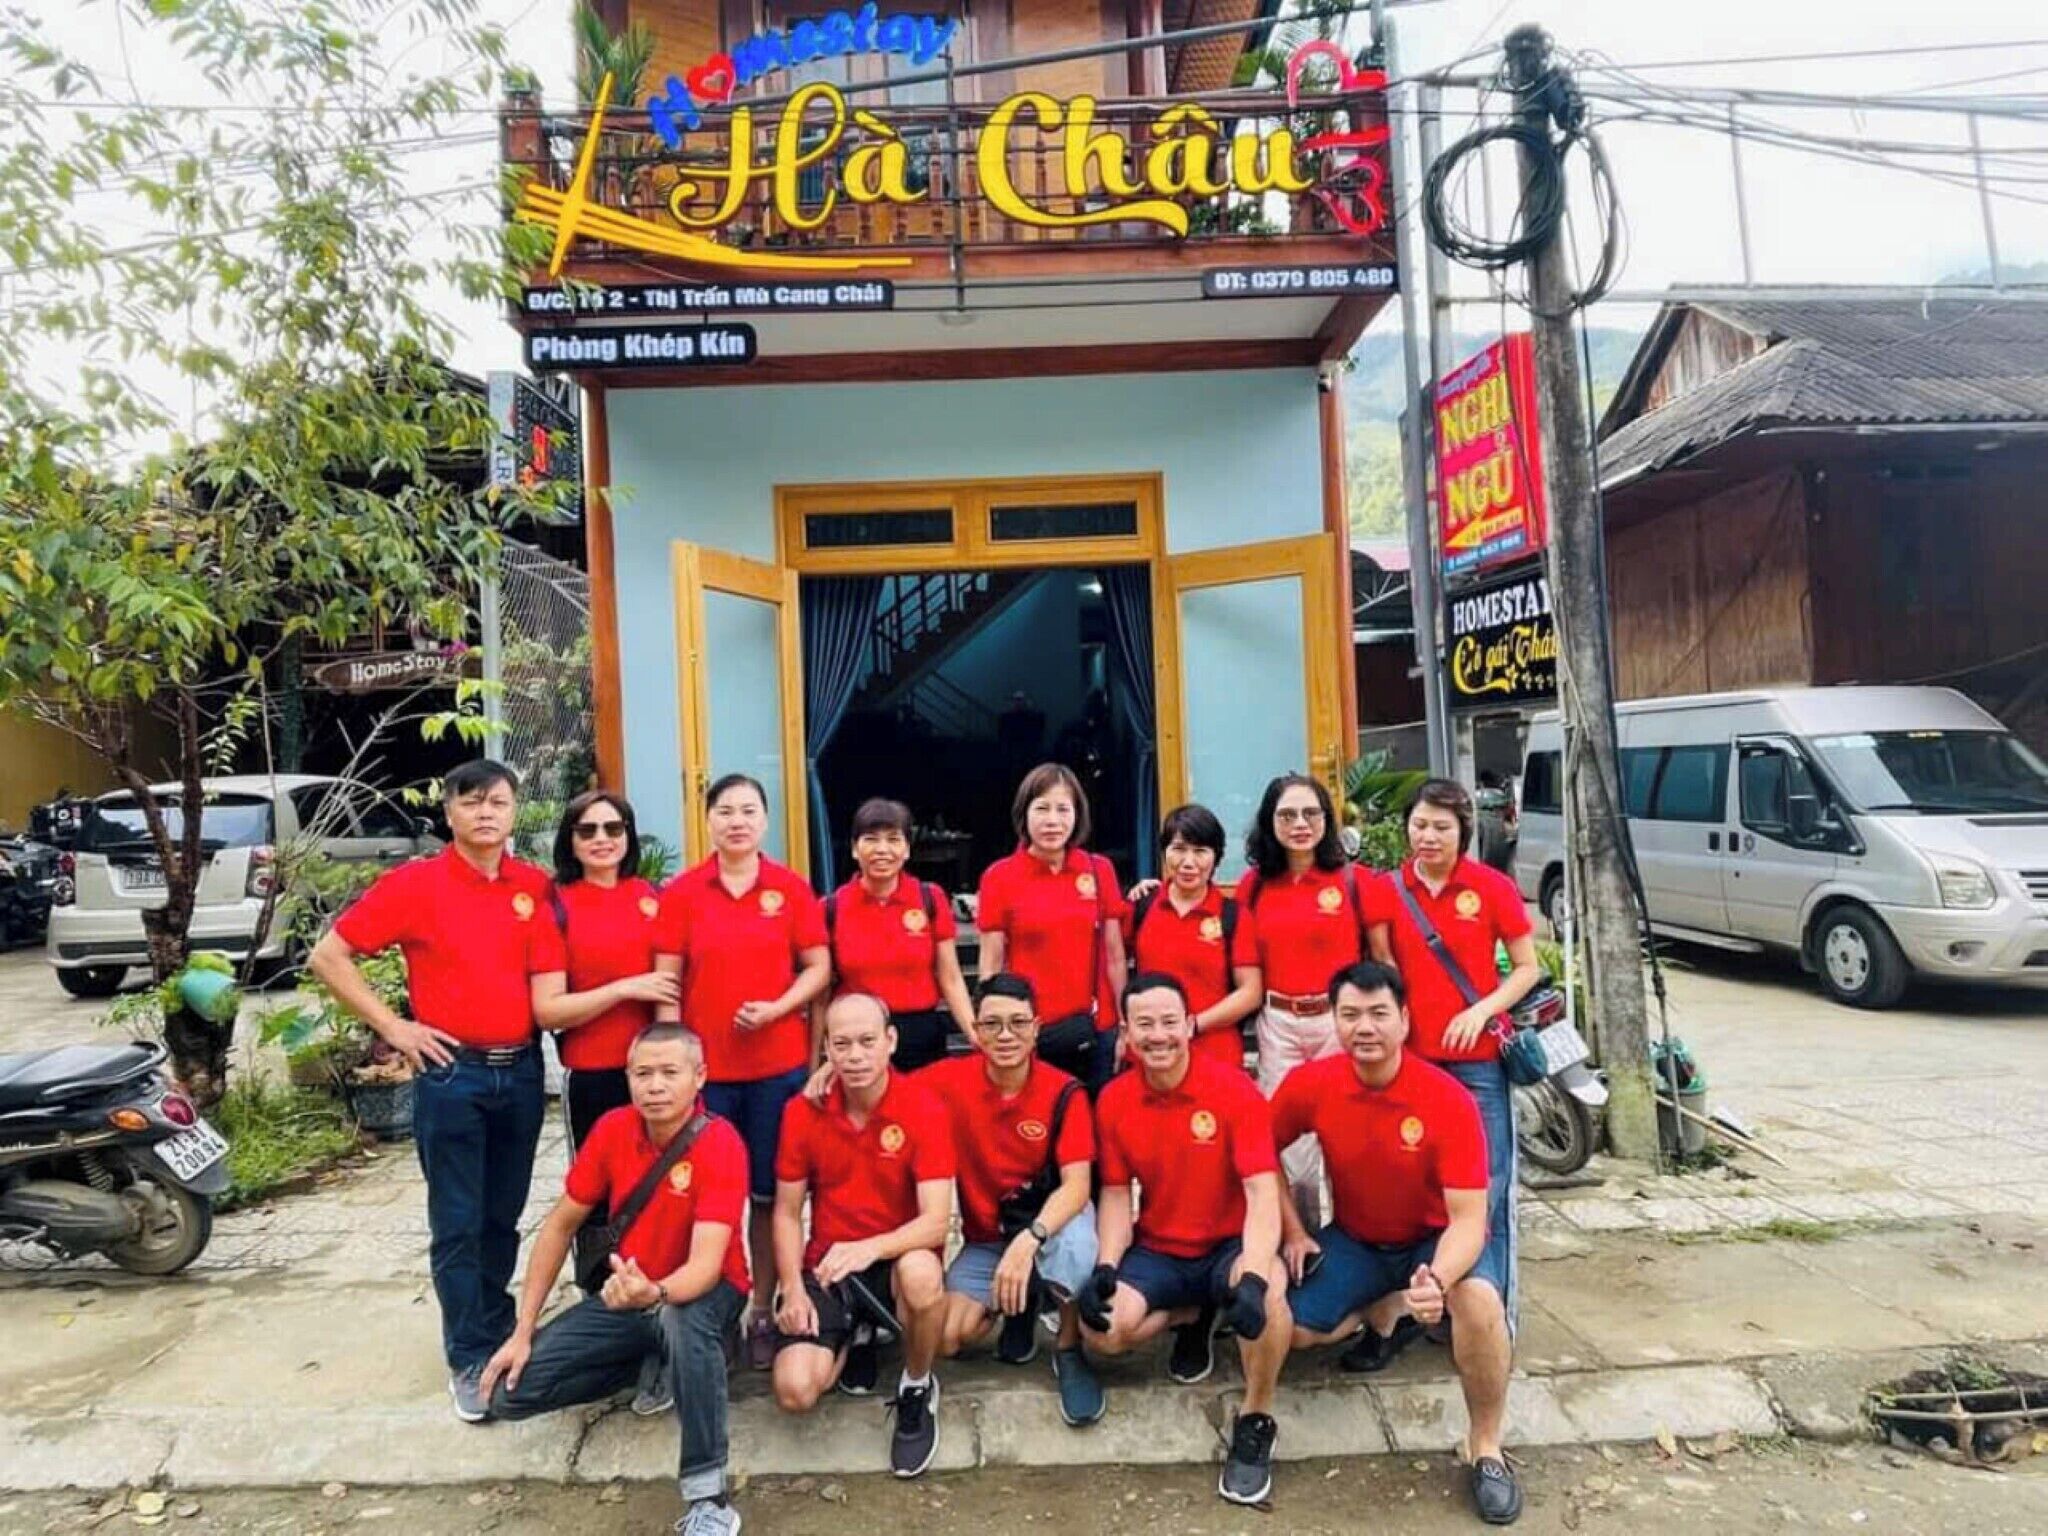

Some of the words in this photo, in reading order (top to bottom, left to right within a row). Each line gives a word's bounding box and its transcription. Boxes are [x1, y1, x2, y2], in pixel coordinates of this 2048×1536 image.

[668, 81, 927, 230] Hà
[977, 92, 1313, 238] Châu
[1251, 270, 1306, 289] 0379
[1309, 268, 1350, 287] 805
[608, 290, 625, 308] 2
[643, 288, 678, 310] Thị
[682, 285, 730, 306] Trấn
[774, 286, 830, 305] Cang
[531, 335, 618, 362] Phòng
[624, 332, 694, 359] Khép
[701, 330, 746, 356] Kín
